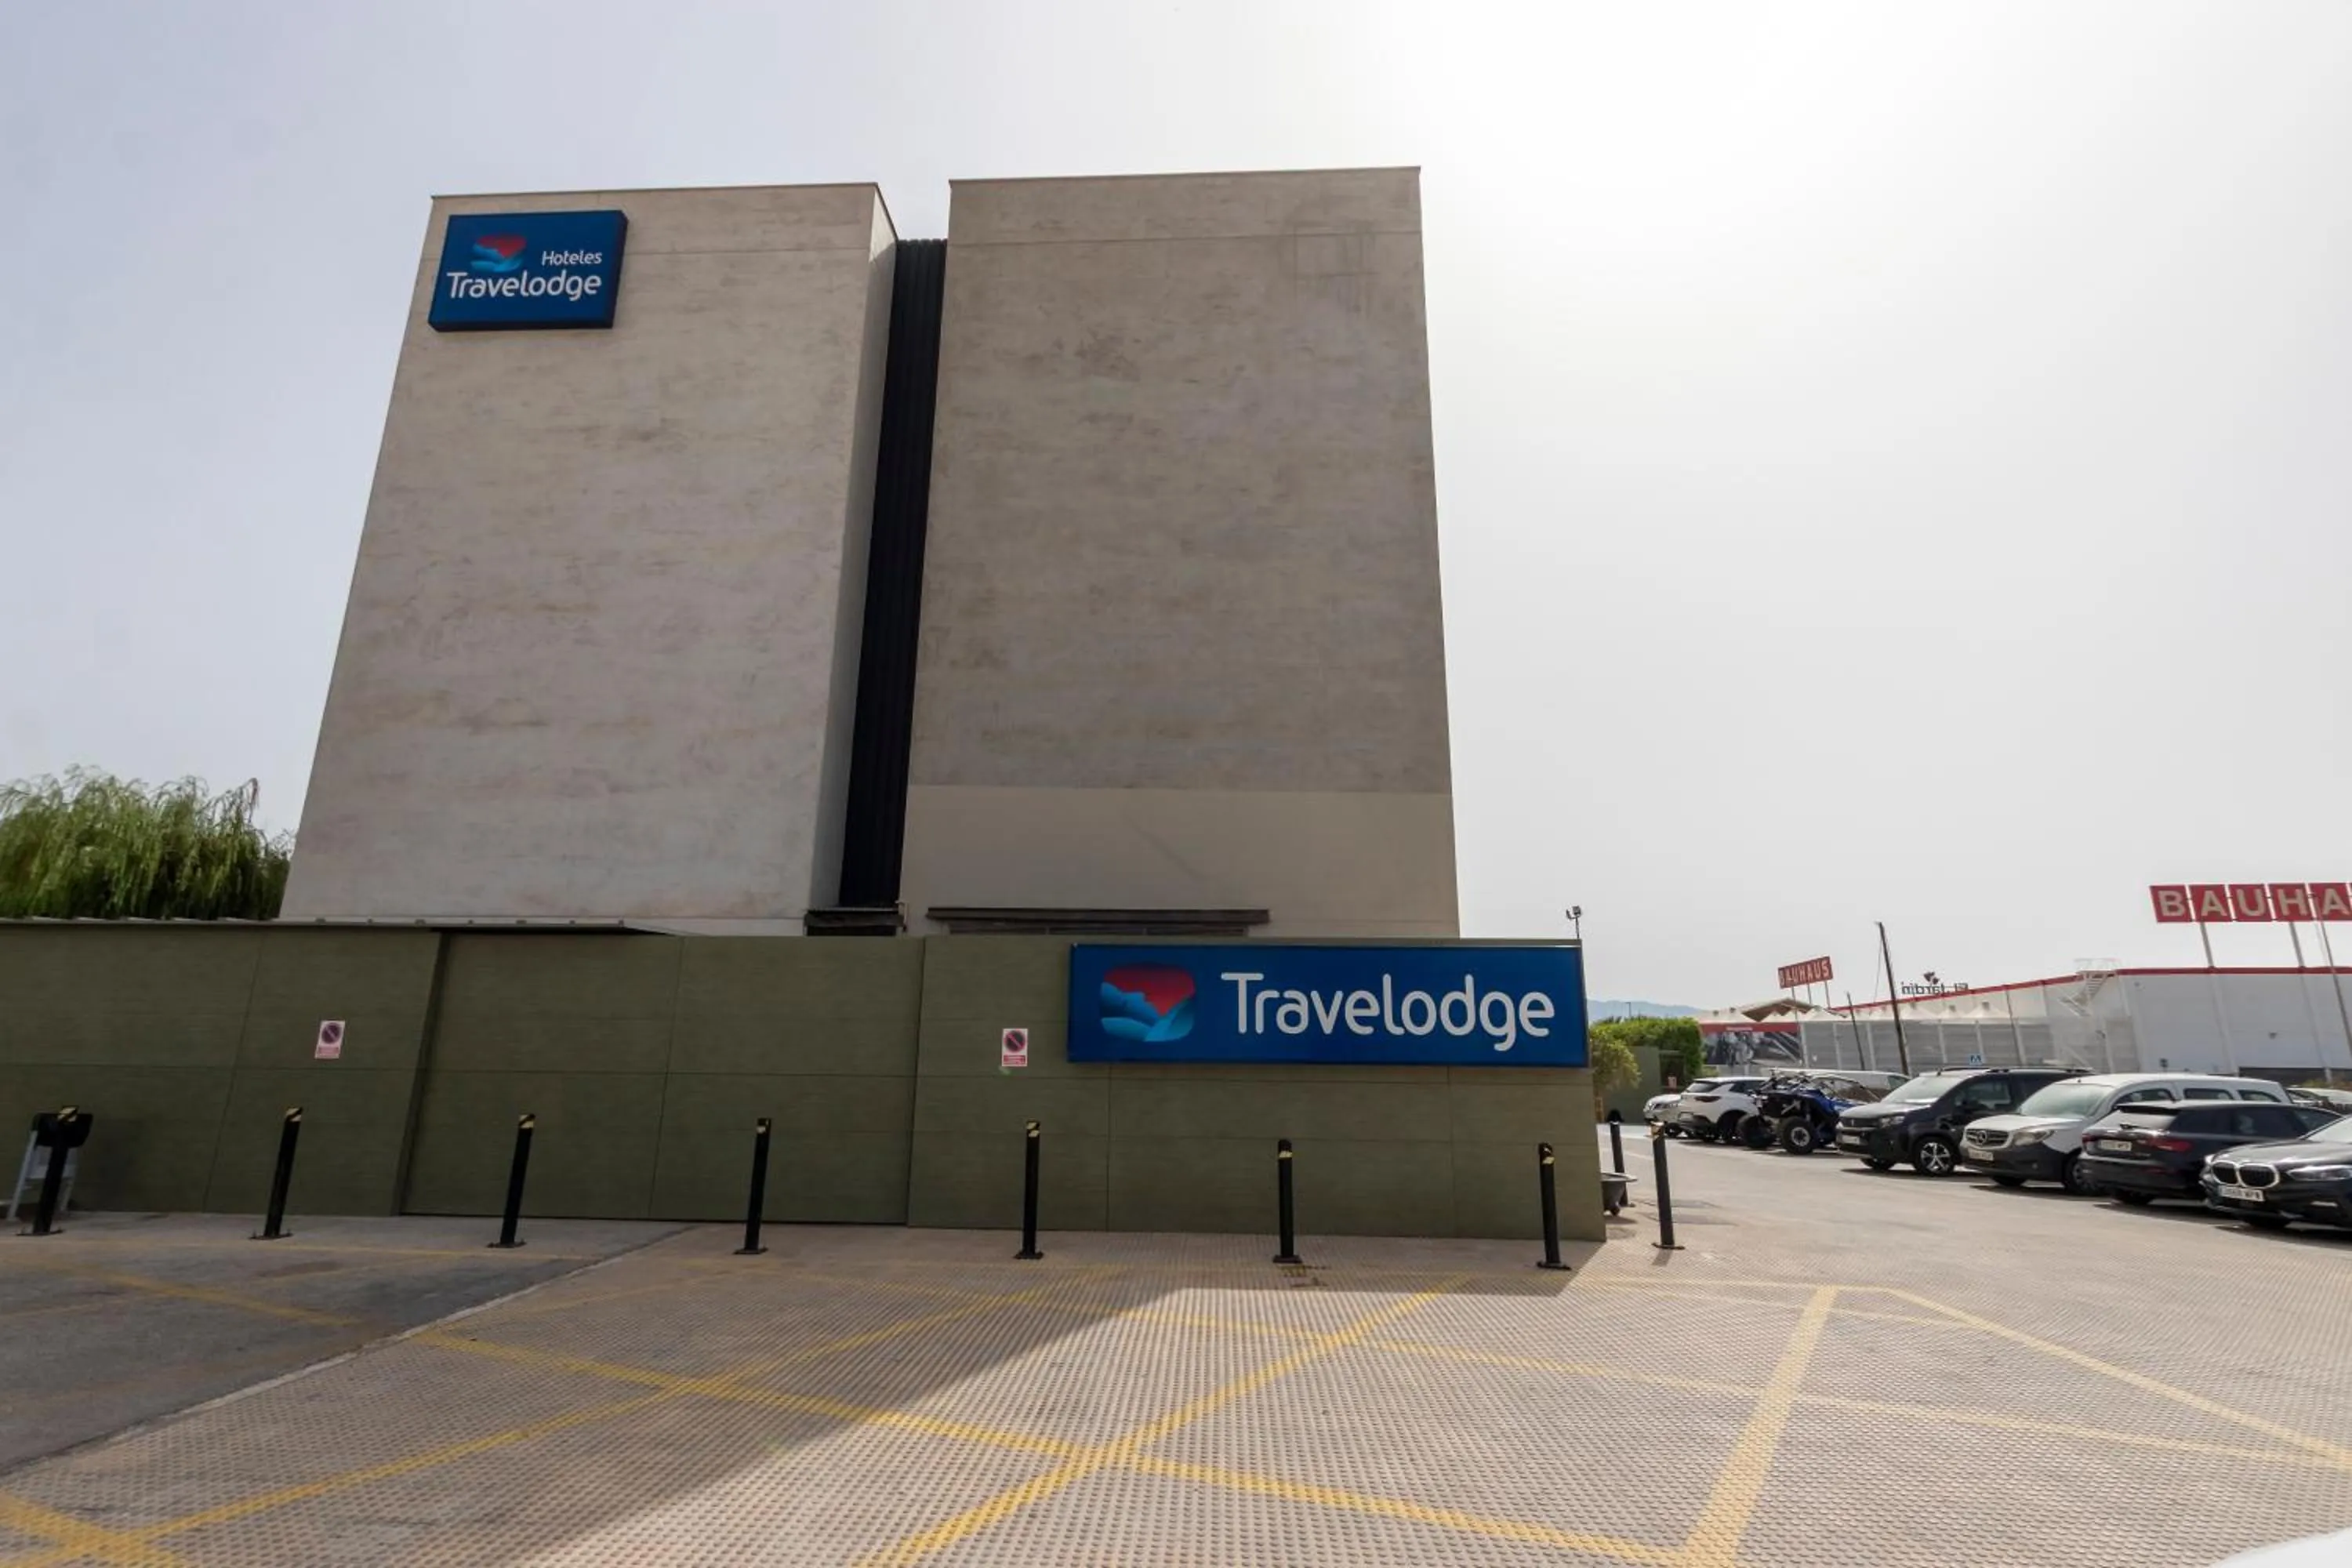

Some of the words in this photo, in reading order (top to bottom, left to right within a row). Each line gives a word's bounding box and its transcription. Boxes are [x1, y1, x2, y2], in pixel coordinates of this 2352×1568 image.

[542, 249, 602, 266] Hoteles
[446, 270, 601, 302] Travelodge
[1221, 972, 1555, 1052] Travelodge
